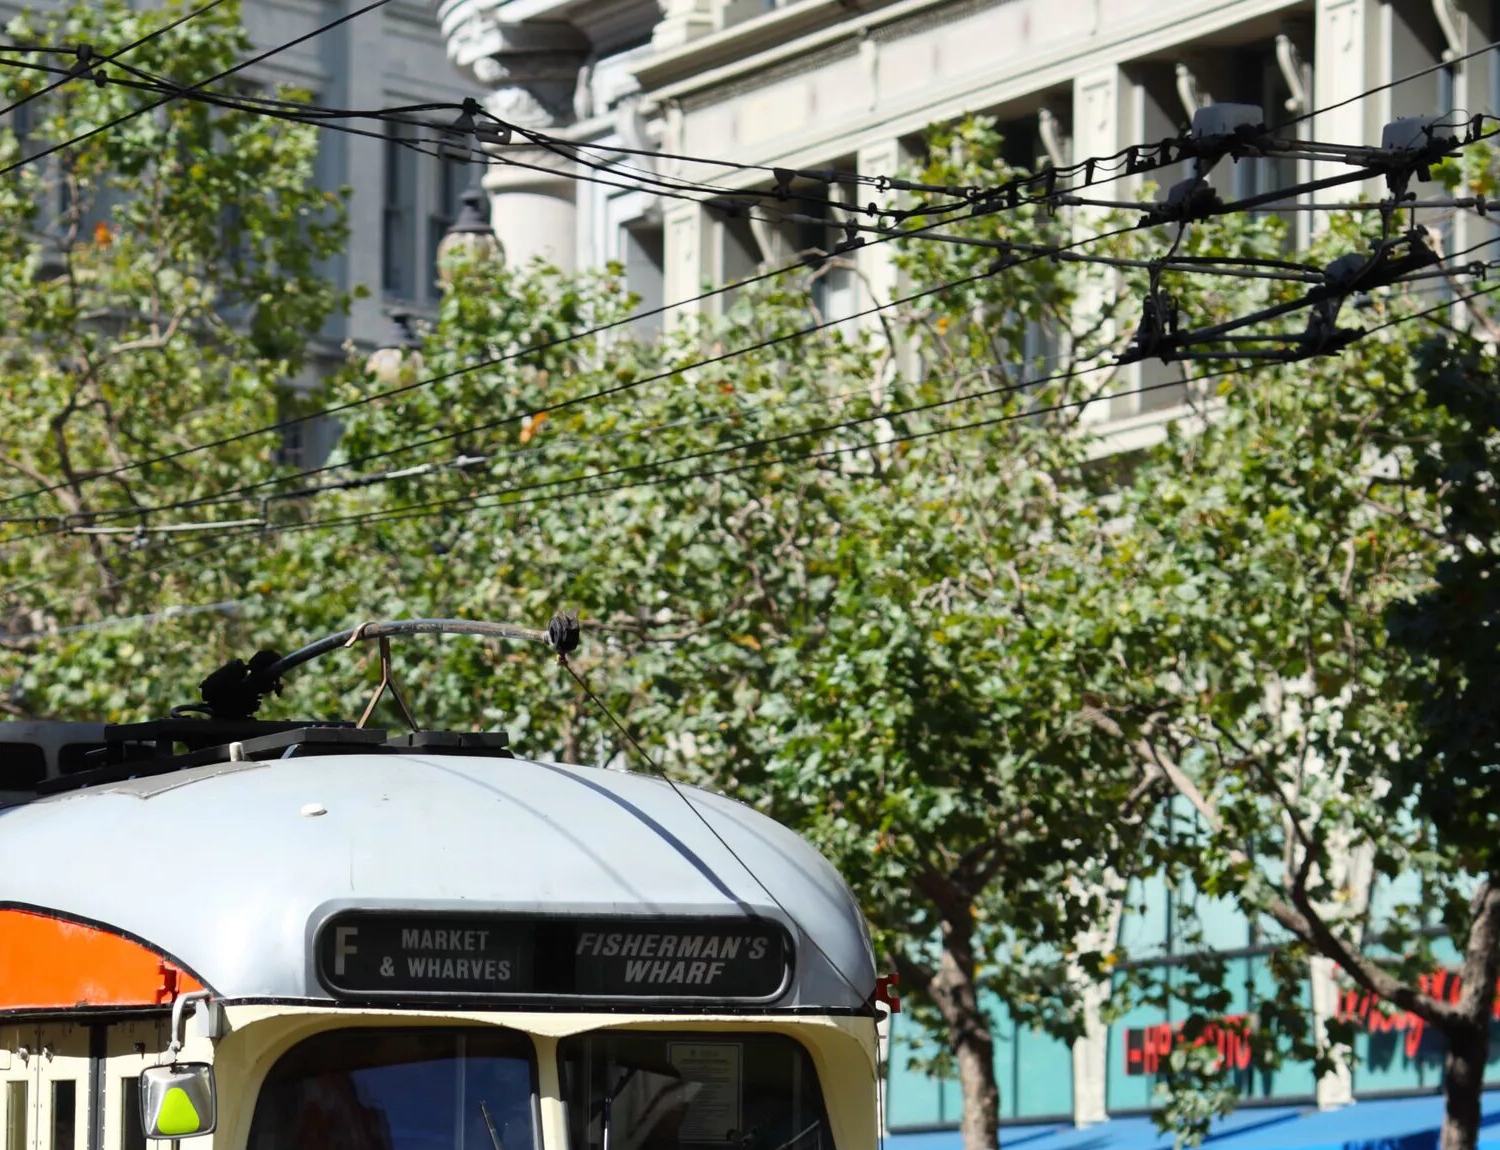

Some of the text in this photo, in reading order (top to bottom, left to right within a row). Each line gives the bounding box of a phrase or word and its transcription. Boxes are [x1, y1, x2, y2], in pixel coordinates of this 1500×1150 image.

[335, 927, 358, 975] F
[402, 929, 489, 951] MARKET
[575, 933, 768, 959] FISHERMAN'S
[380, 957, 511, 980] & WHARVES
[624, 960, 725, 984] WHARF
